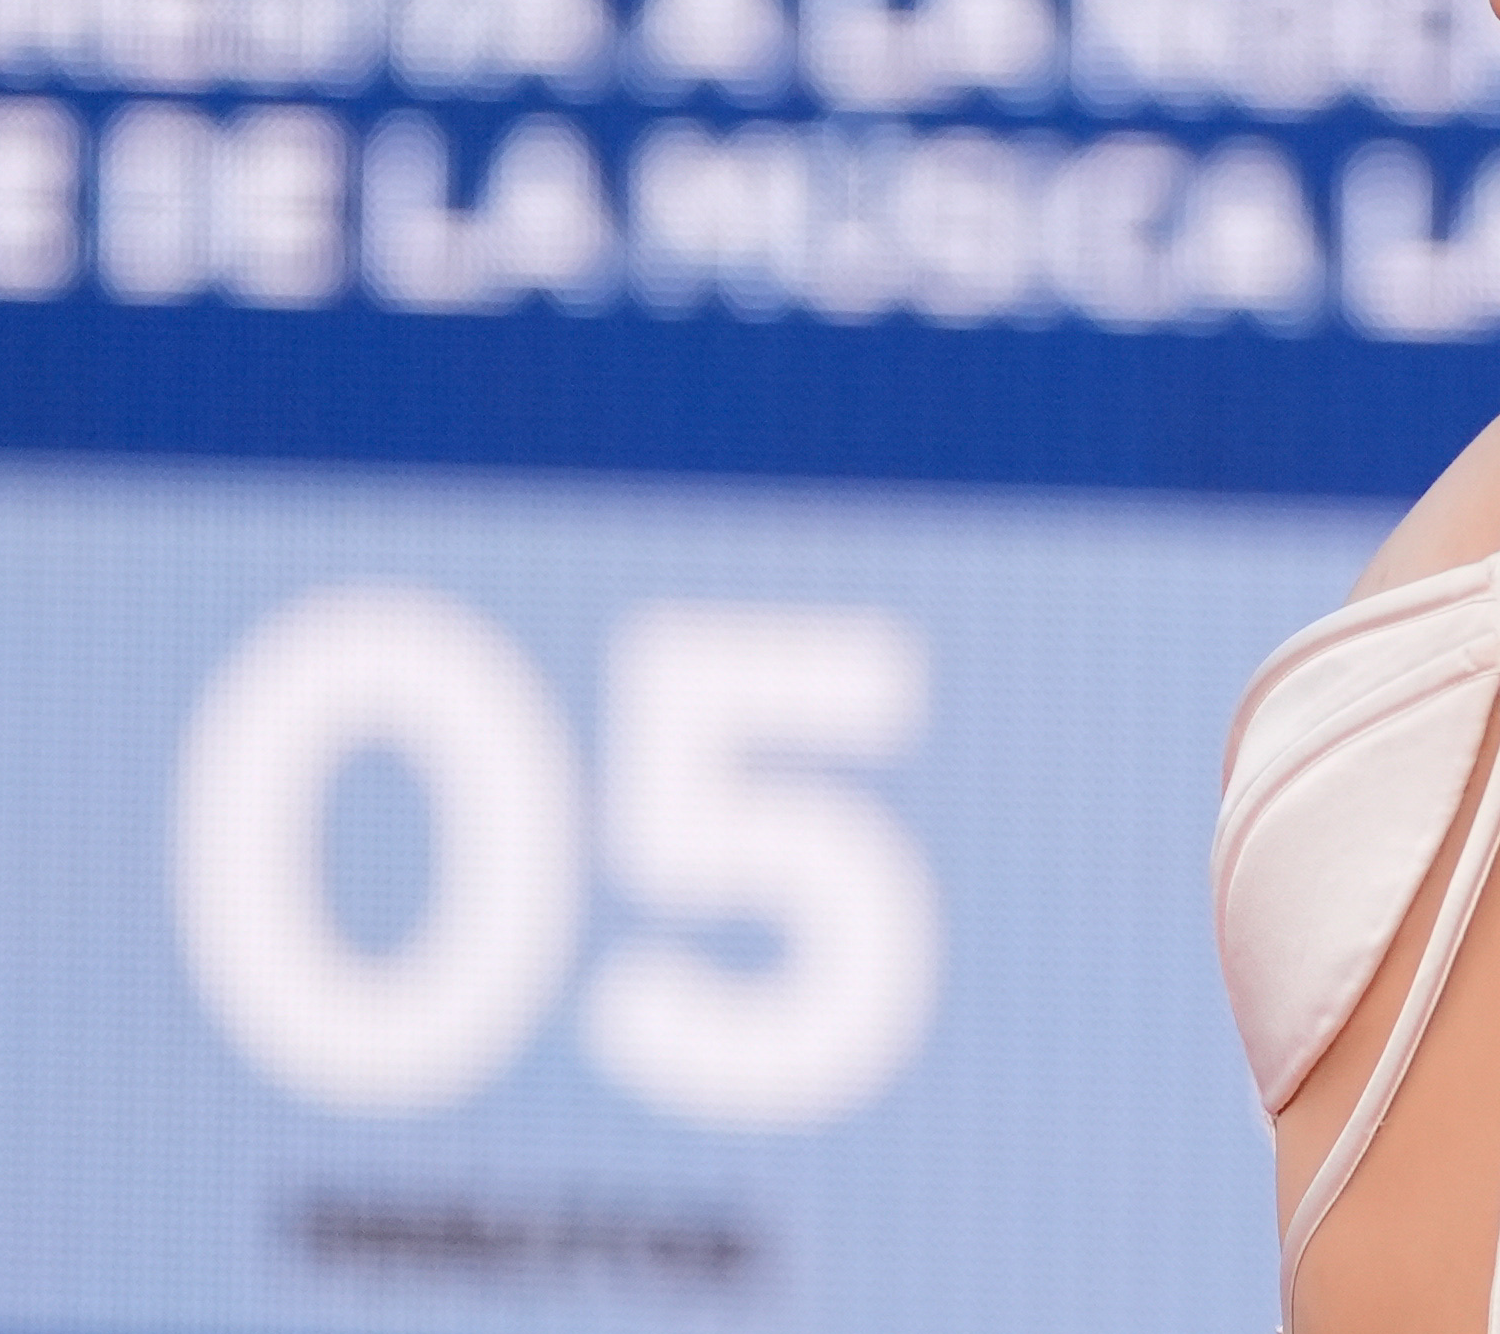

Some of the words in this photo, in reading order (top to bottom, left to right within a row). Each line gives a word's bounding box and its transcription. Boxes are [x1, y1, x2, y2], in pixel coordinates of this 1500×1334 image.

[100, 99, 348, 307] DE
[360, 111, 615, 315] LA
[172, 579, 940, 1132] 05
